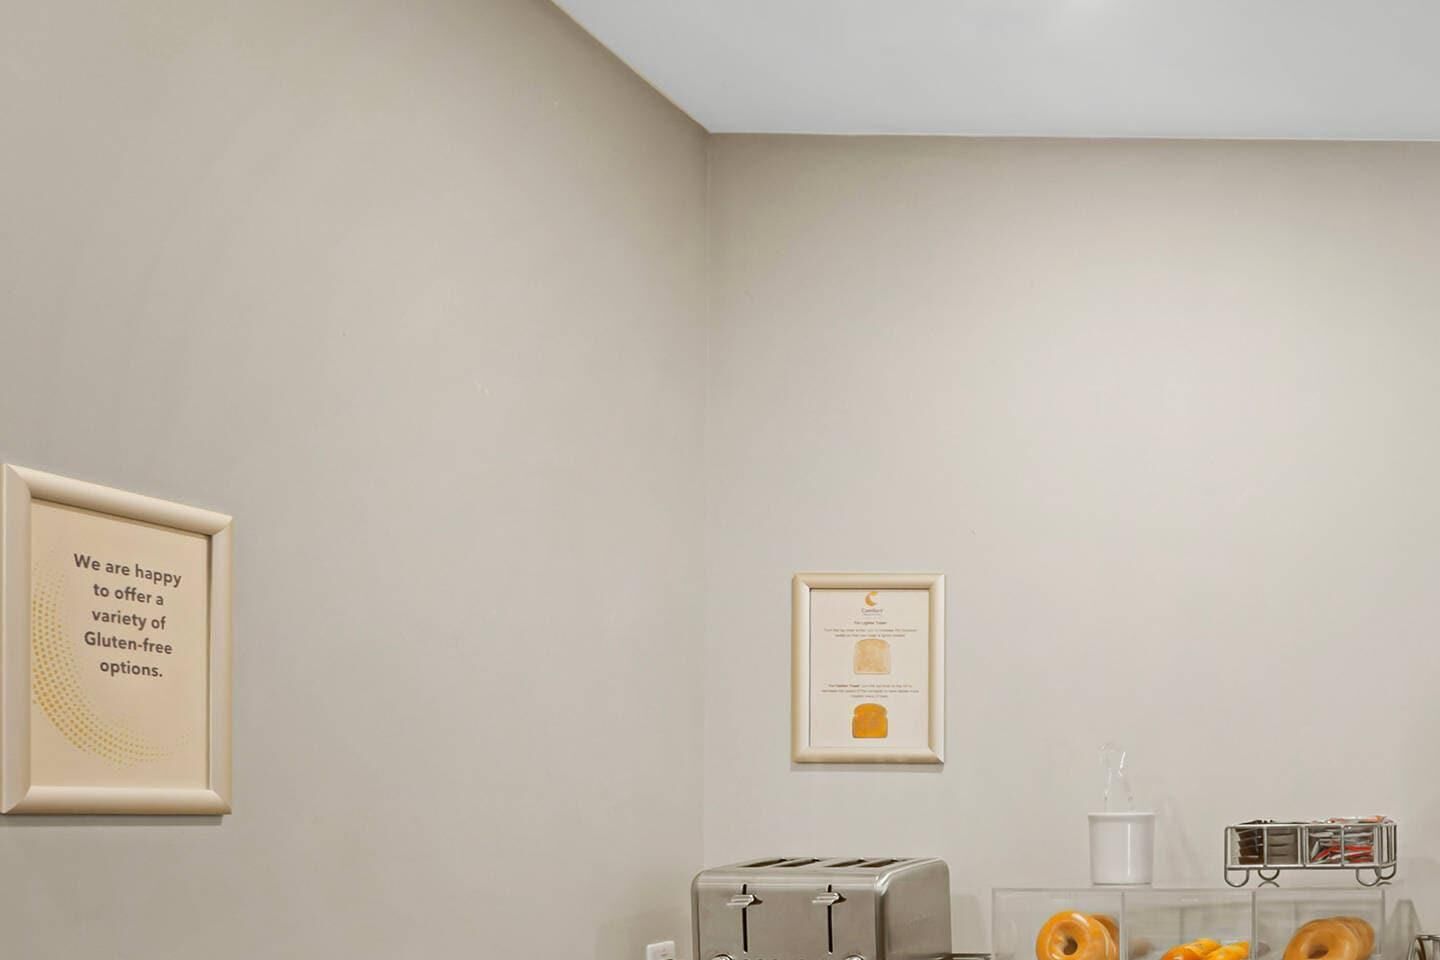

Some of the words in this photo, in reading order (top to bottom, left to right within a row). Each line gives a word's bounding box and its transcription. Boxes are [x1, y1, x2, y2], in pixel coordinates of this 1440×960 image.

[73, 553, 101, 571] We
[105, 562, 131, 576] are
[135, 563, 182, 588] happy
[93, 584, 110, 598] to
[114, 586, 152, 604] offer
[155, 595, 164, 606] a
[92, 610, 147, 631] variety
[151, 616, 166, 630] of
[84, 631, 173, 654] Gluten-free
[100, 660, 163, 677] options.
